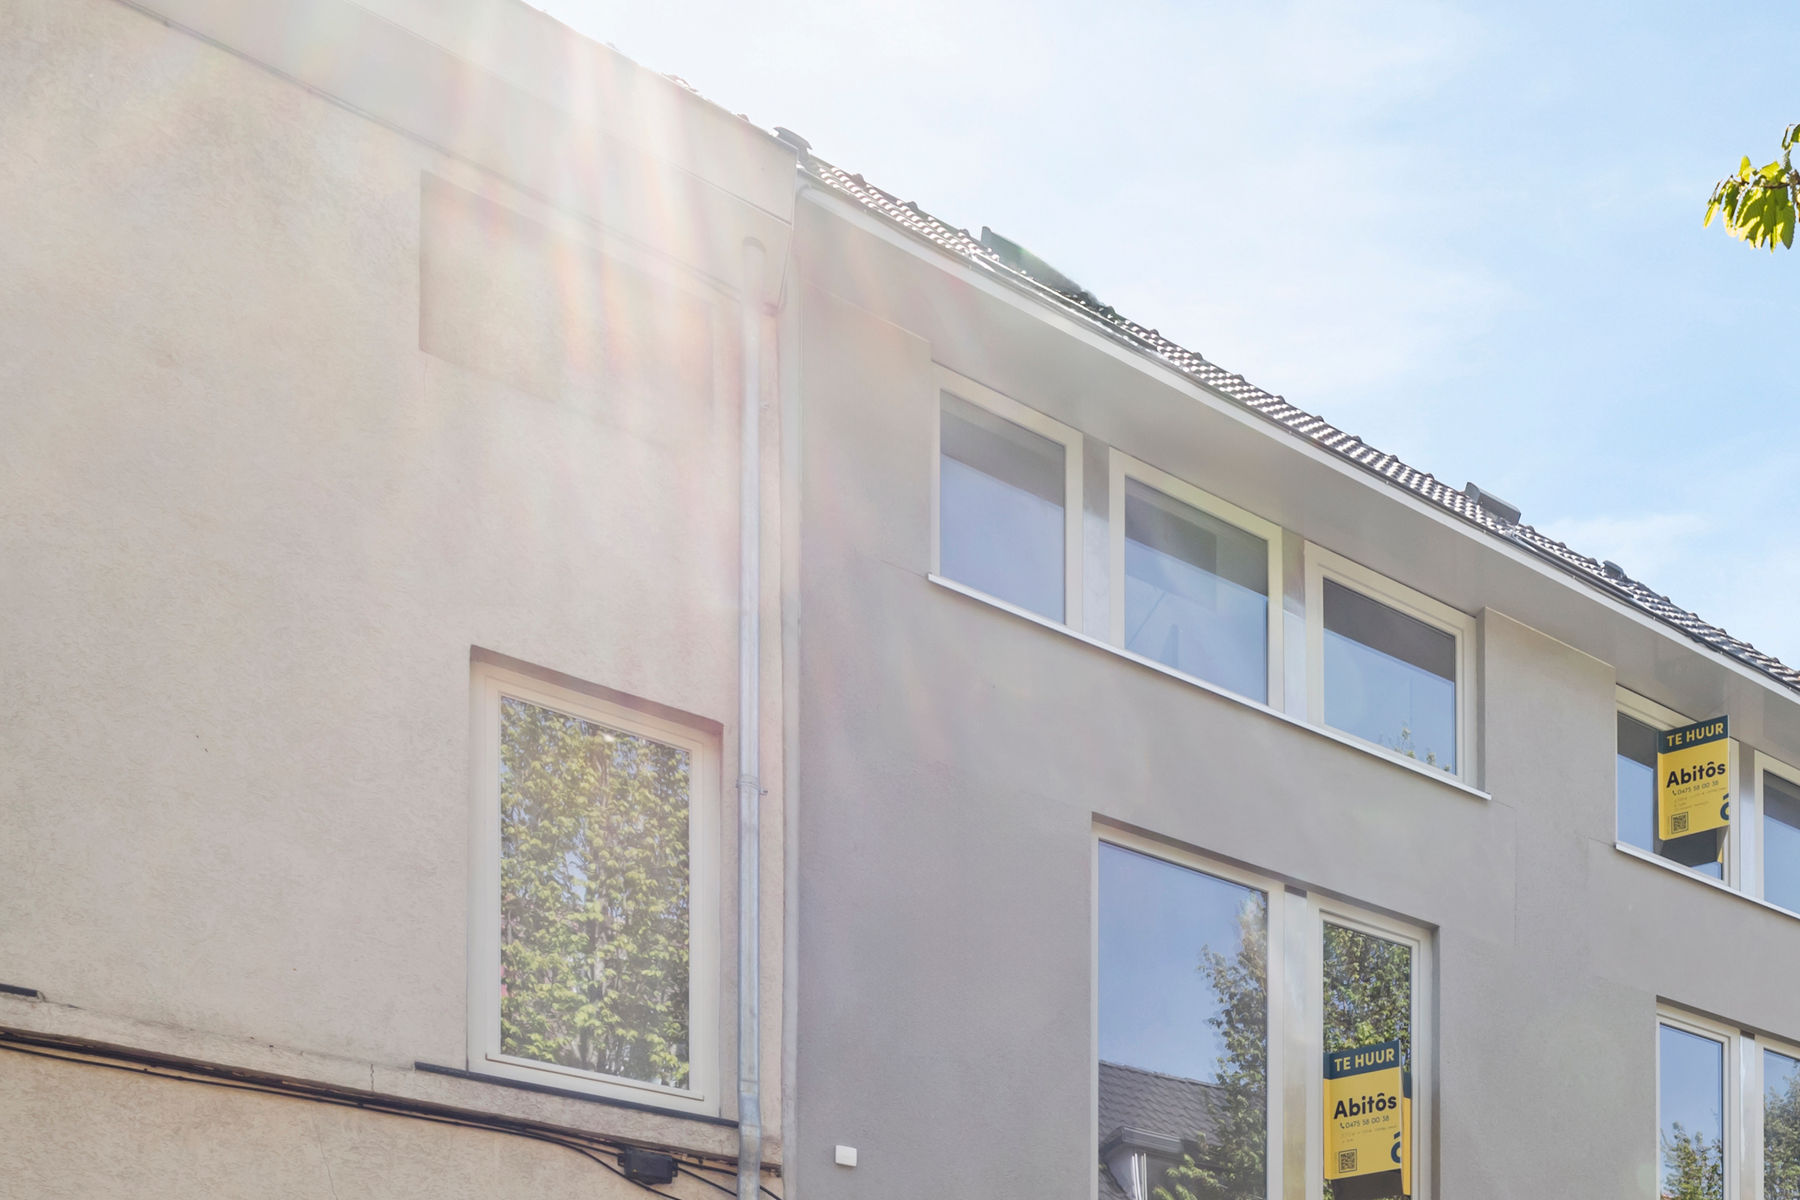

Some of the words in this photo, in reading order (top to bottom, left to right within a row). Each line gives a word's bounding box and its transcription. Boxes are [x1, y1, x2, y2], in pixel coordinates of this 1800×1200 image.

[1667, 733, 1683, 747] TE
[1687, 722, 1723, 742] HUUR
[1666, 761, 1726, 788] Abitôs
[1334, 1056, 1351, 1072] TE
[1354, 1048, 1395, 1068] HUUR
[1333, 1092, 1397, 1119] Abitôs
